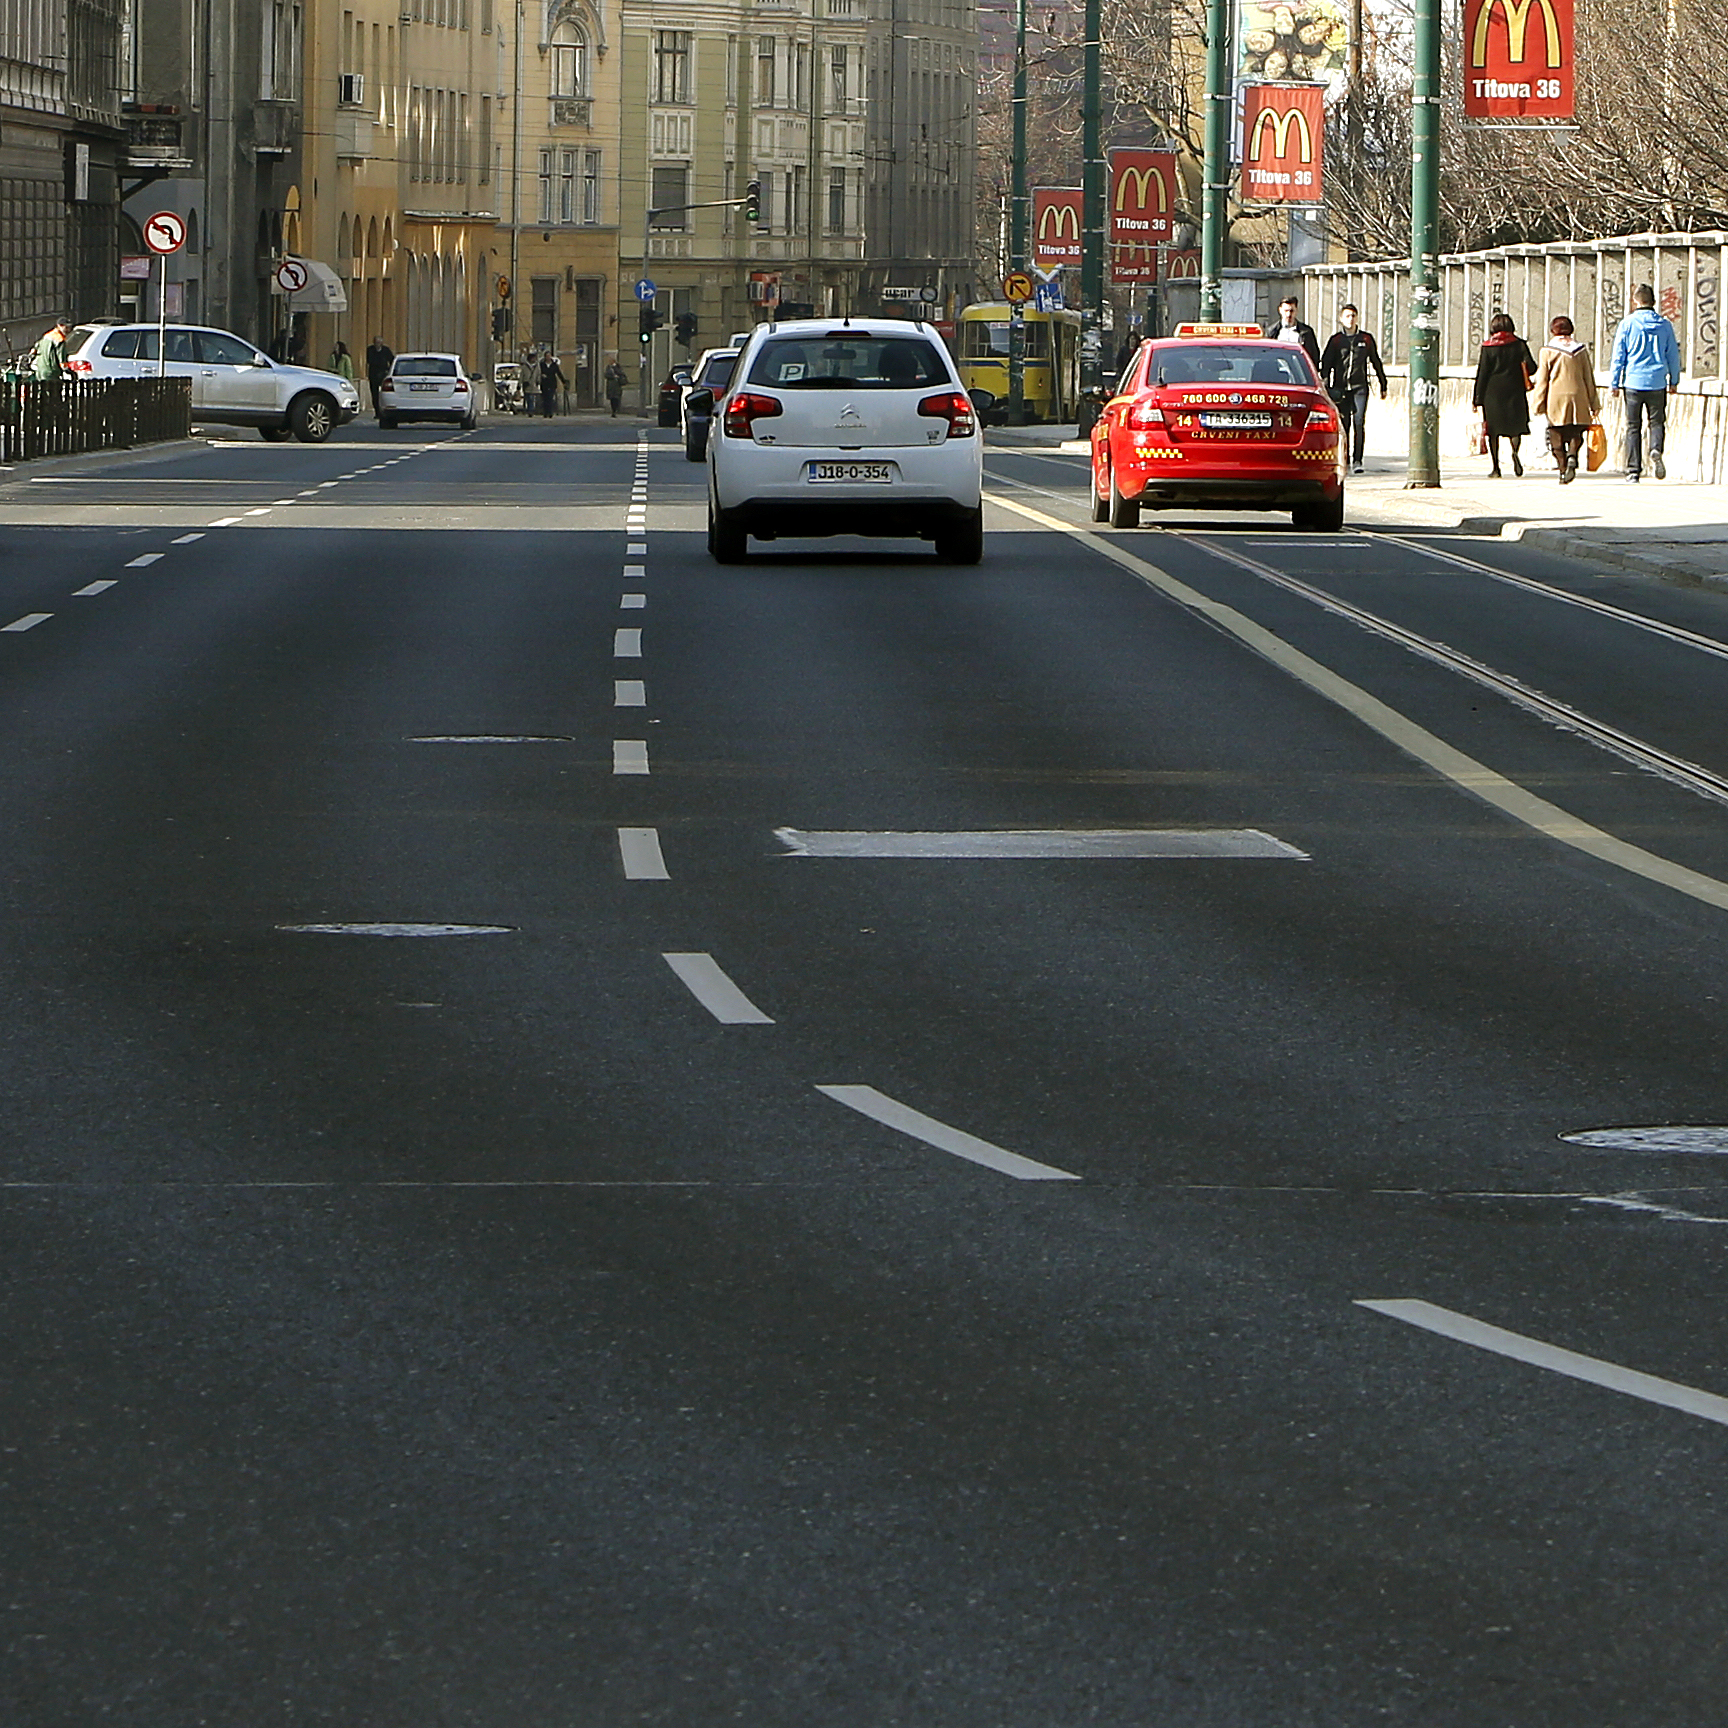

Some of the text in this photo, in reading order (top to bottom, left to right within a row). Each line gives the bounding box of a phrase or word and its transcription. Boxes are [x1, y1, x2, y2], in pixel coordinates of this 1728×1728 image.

[1472, 78, 1561, 99] Titova 36
[1248, 169, 1313, 186] Titova 36
[1115, 217, 1166, 231] Titova 36
[1038, 244, 1080, 256] Titova 36
[784, 365, 802, 380] P
[1244, 394, 1266, 404] 468
[1268, 394, 1289, 405] 728
[1177, 414, 1193, 427] 14
[1277, 415, 1293, 428] 14
[1190, 430, 1277, 439] CRVENI TAXI
